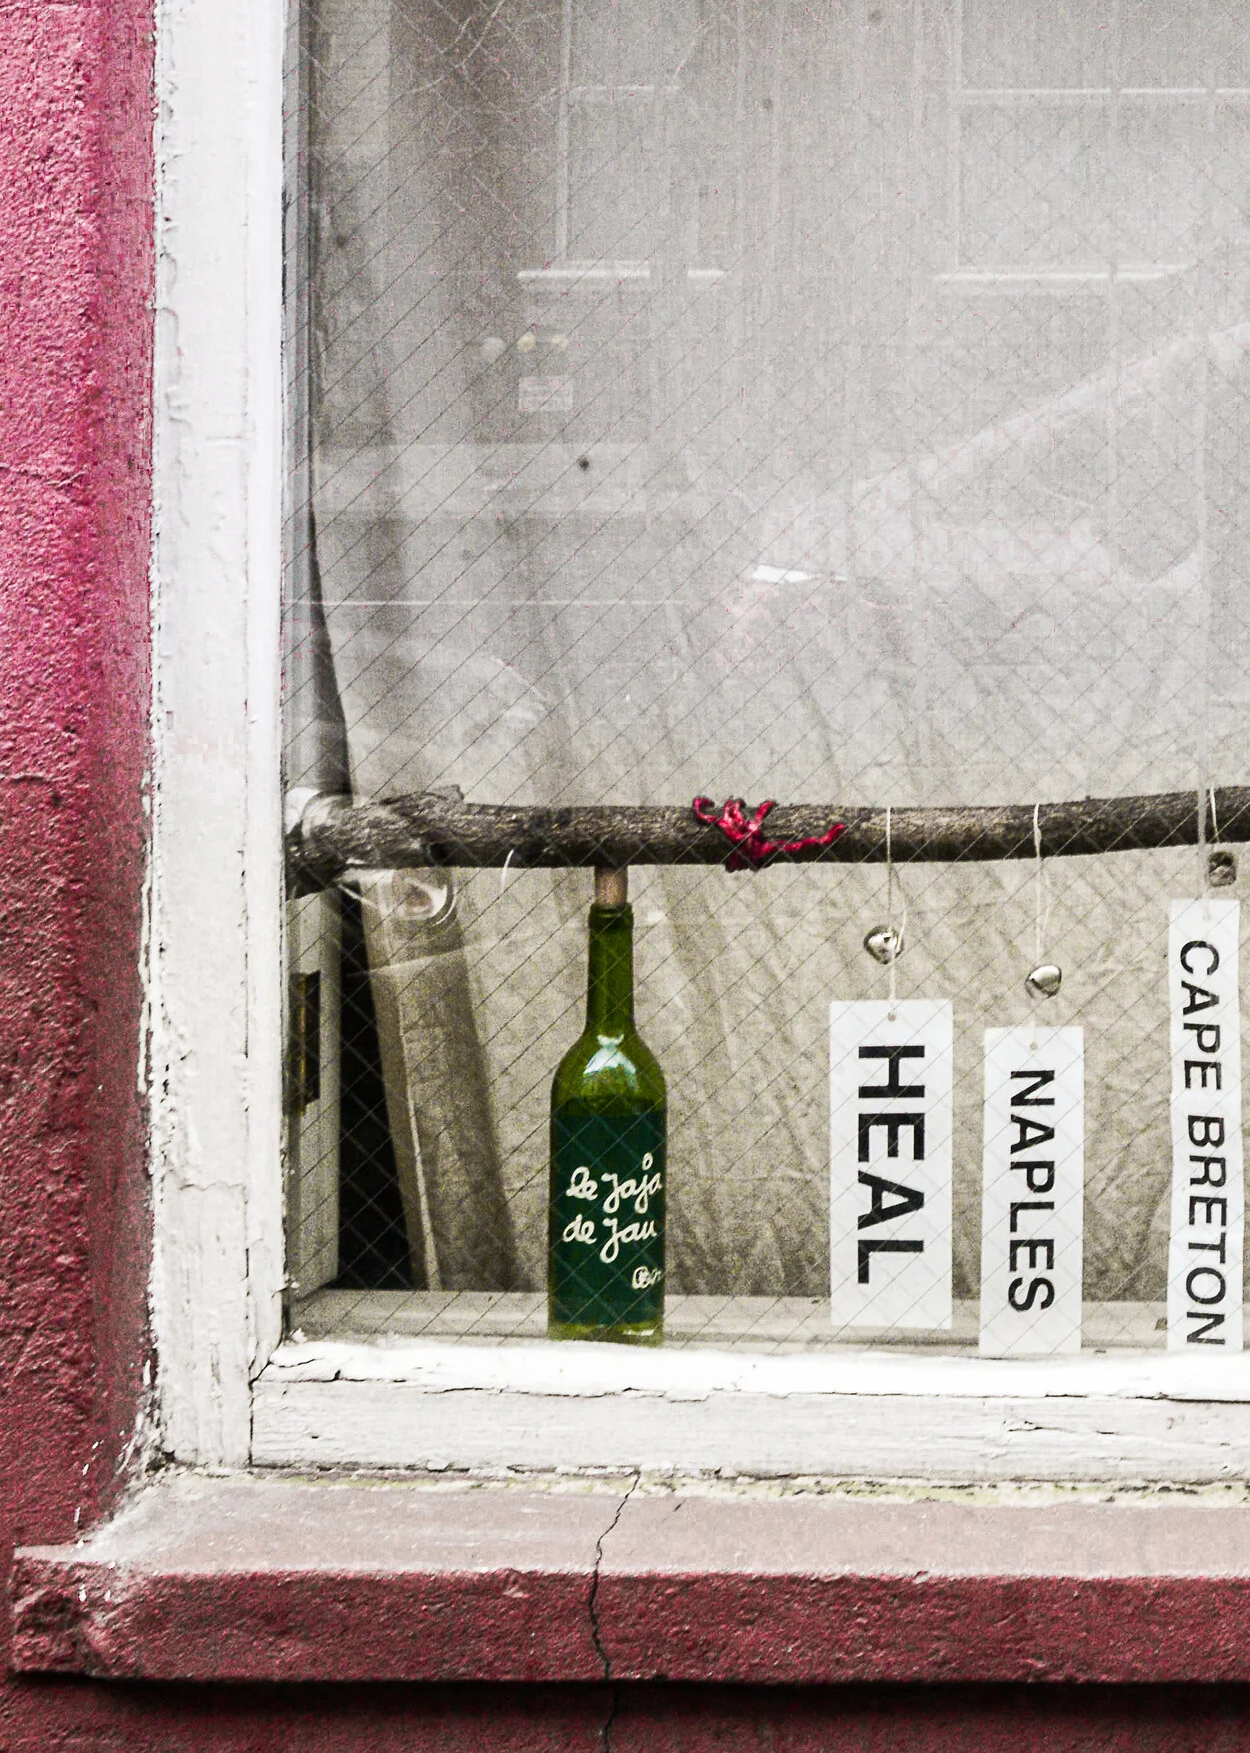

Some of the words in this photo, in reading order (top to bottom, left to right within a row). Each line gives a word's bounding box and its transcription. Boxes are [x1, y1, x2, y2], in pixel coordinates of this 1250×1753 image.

[1181, 941, 1221, 1089] CAPE
[562, 1213, 597, 1245] de
[858, 1046, 925, 1283] HEAL
[1008, 1070, 1054, 1311] NAPLES
[1186, 1115, 1227, 1344] BRETON
